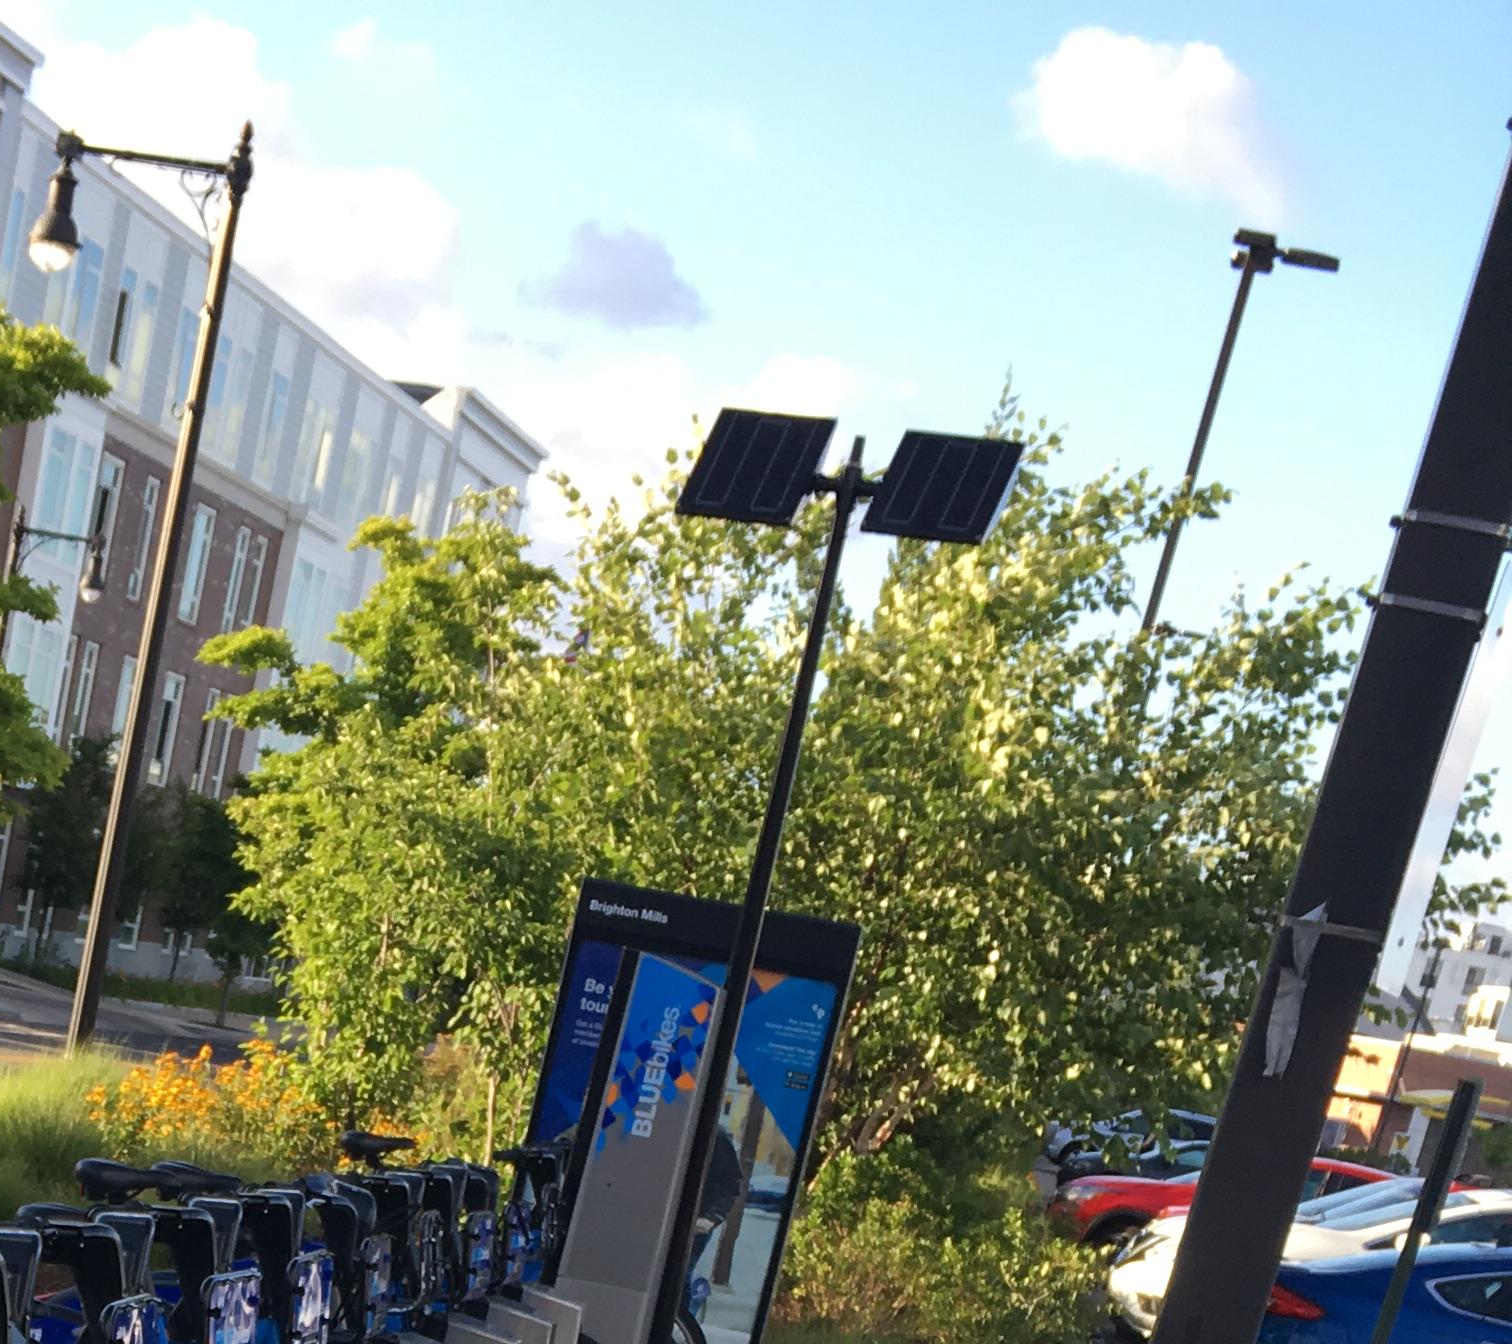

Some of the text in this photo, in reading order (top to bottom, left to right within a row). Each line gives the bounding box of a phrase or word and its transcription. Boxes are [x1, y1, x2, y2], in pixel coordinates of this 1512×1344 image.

[590, 899, 669, 924] Brighton Mills
[583, 978, 605, 995] Be
[631, 1006, 681, 1138] BLUEbikes
